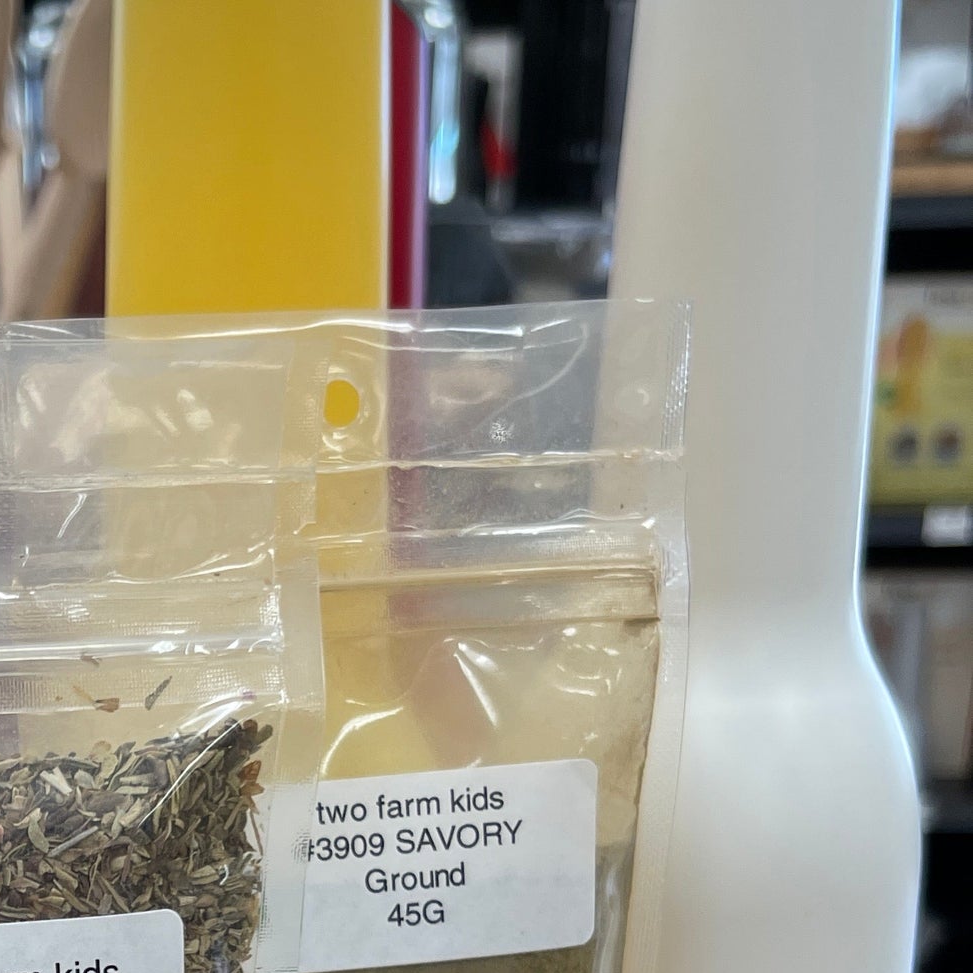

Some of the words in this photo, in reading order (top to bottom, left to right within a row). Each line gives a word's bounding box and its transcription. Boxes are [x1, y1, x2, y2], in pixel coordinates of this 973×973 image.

[315, 802, 368, 825] two
[375, 794, 442, 820] farm
[449, 786, 505, 813] kids
[395, 819, 524, 854] SAVORY
[364, 862, 466, 894] Ground
[387, 900, 446, 927] 45G
